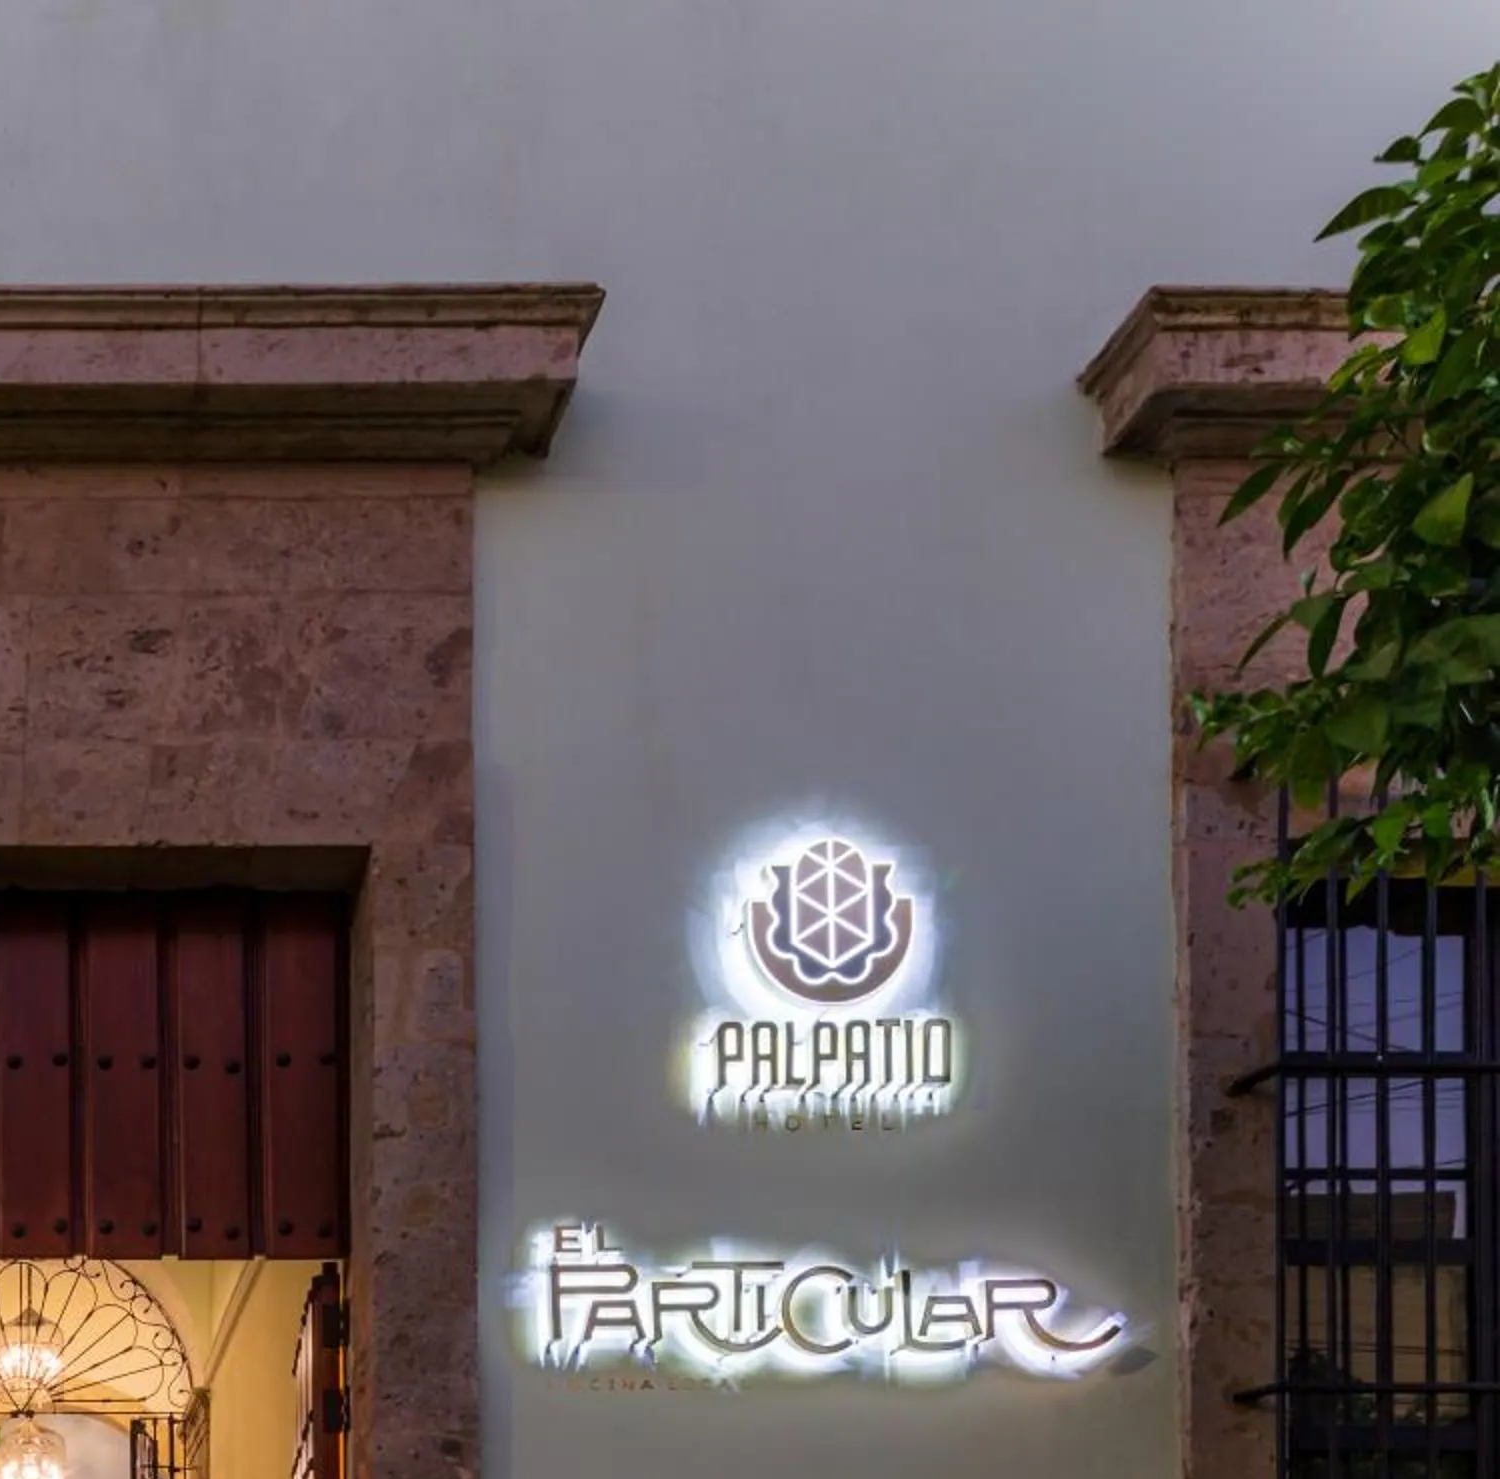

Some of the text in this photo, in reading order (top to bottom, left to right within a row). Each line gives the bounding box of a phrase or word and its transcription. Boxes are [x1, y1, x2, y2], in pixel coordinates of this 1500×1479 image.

[716, 1018, 952, 1087] PALPATIO
[754, 1112, 895, 1133] HOTEL
[554, 1225, 622, 1253] EL
[550, 1260, 1124, 1356] PARTICULAR
